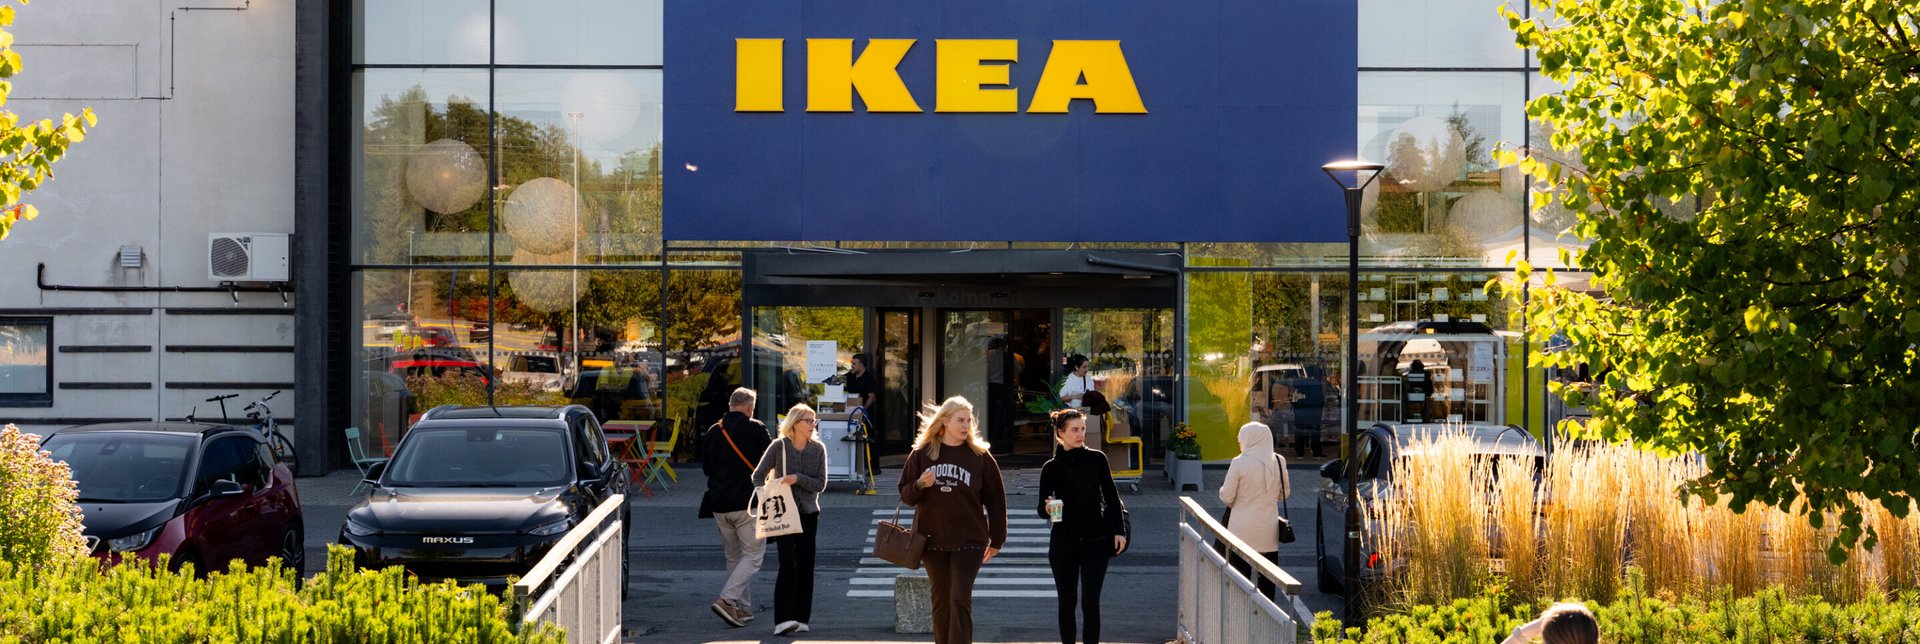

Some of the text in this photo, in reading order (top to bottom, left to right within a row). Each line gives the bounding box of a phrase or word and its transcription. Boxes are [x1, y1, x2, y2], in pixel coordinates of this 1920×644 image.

[734, 38, 1149, 113] IKEA
[925, 463, 971, 487] ROOKLYN
[422, 536, 474, 544] MAXUS
